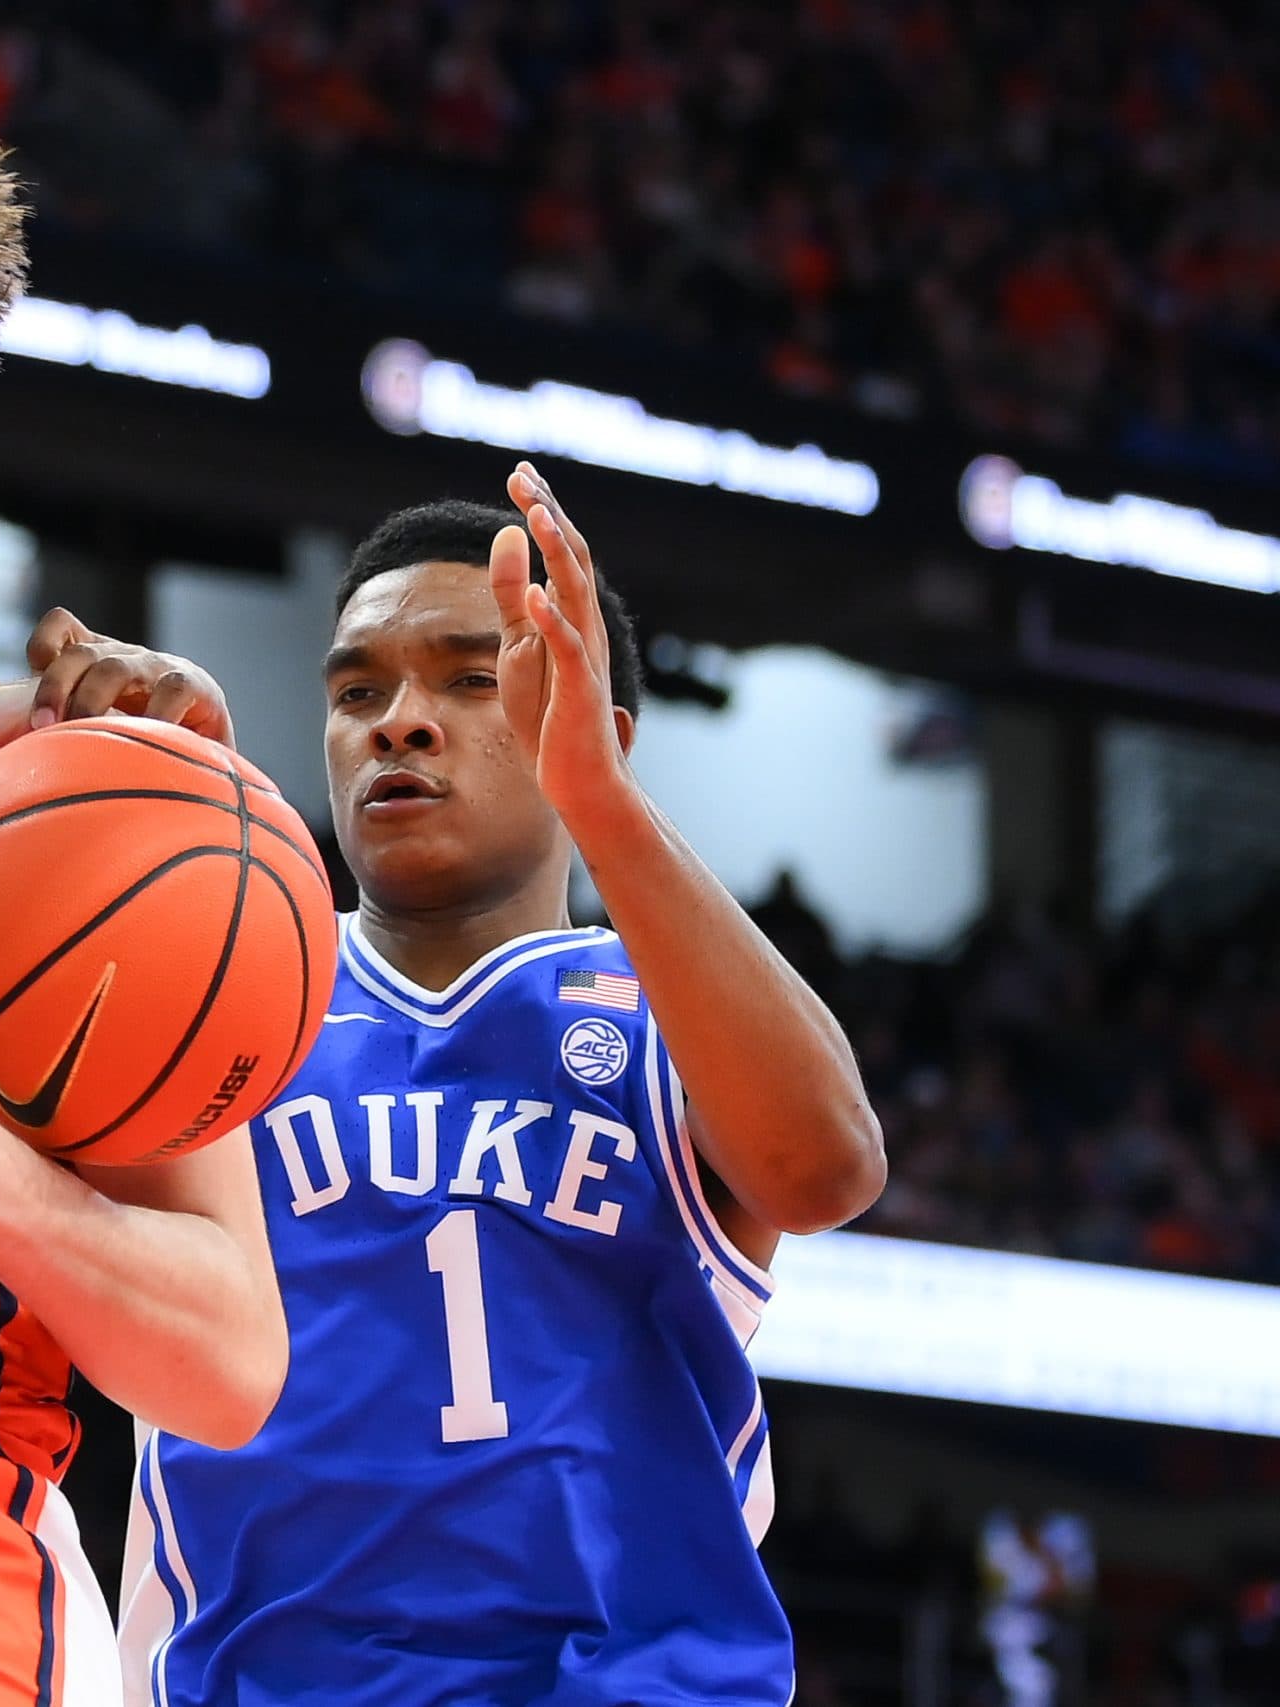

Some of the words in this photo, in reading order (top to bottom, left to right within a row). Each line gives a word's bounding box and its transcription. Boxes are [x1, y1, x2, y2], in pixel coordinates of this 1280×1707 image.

[129, 1053, 261, 1163] RACUSE
[573, 1040, 624, 1059] ACC
[264, 1090, 637, 1237] DUKE
[425, 1208, 509, 1443] 1
